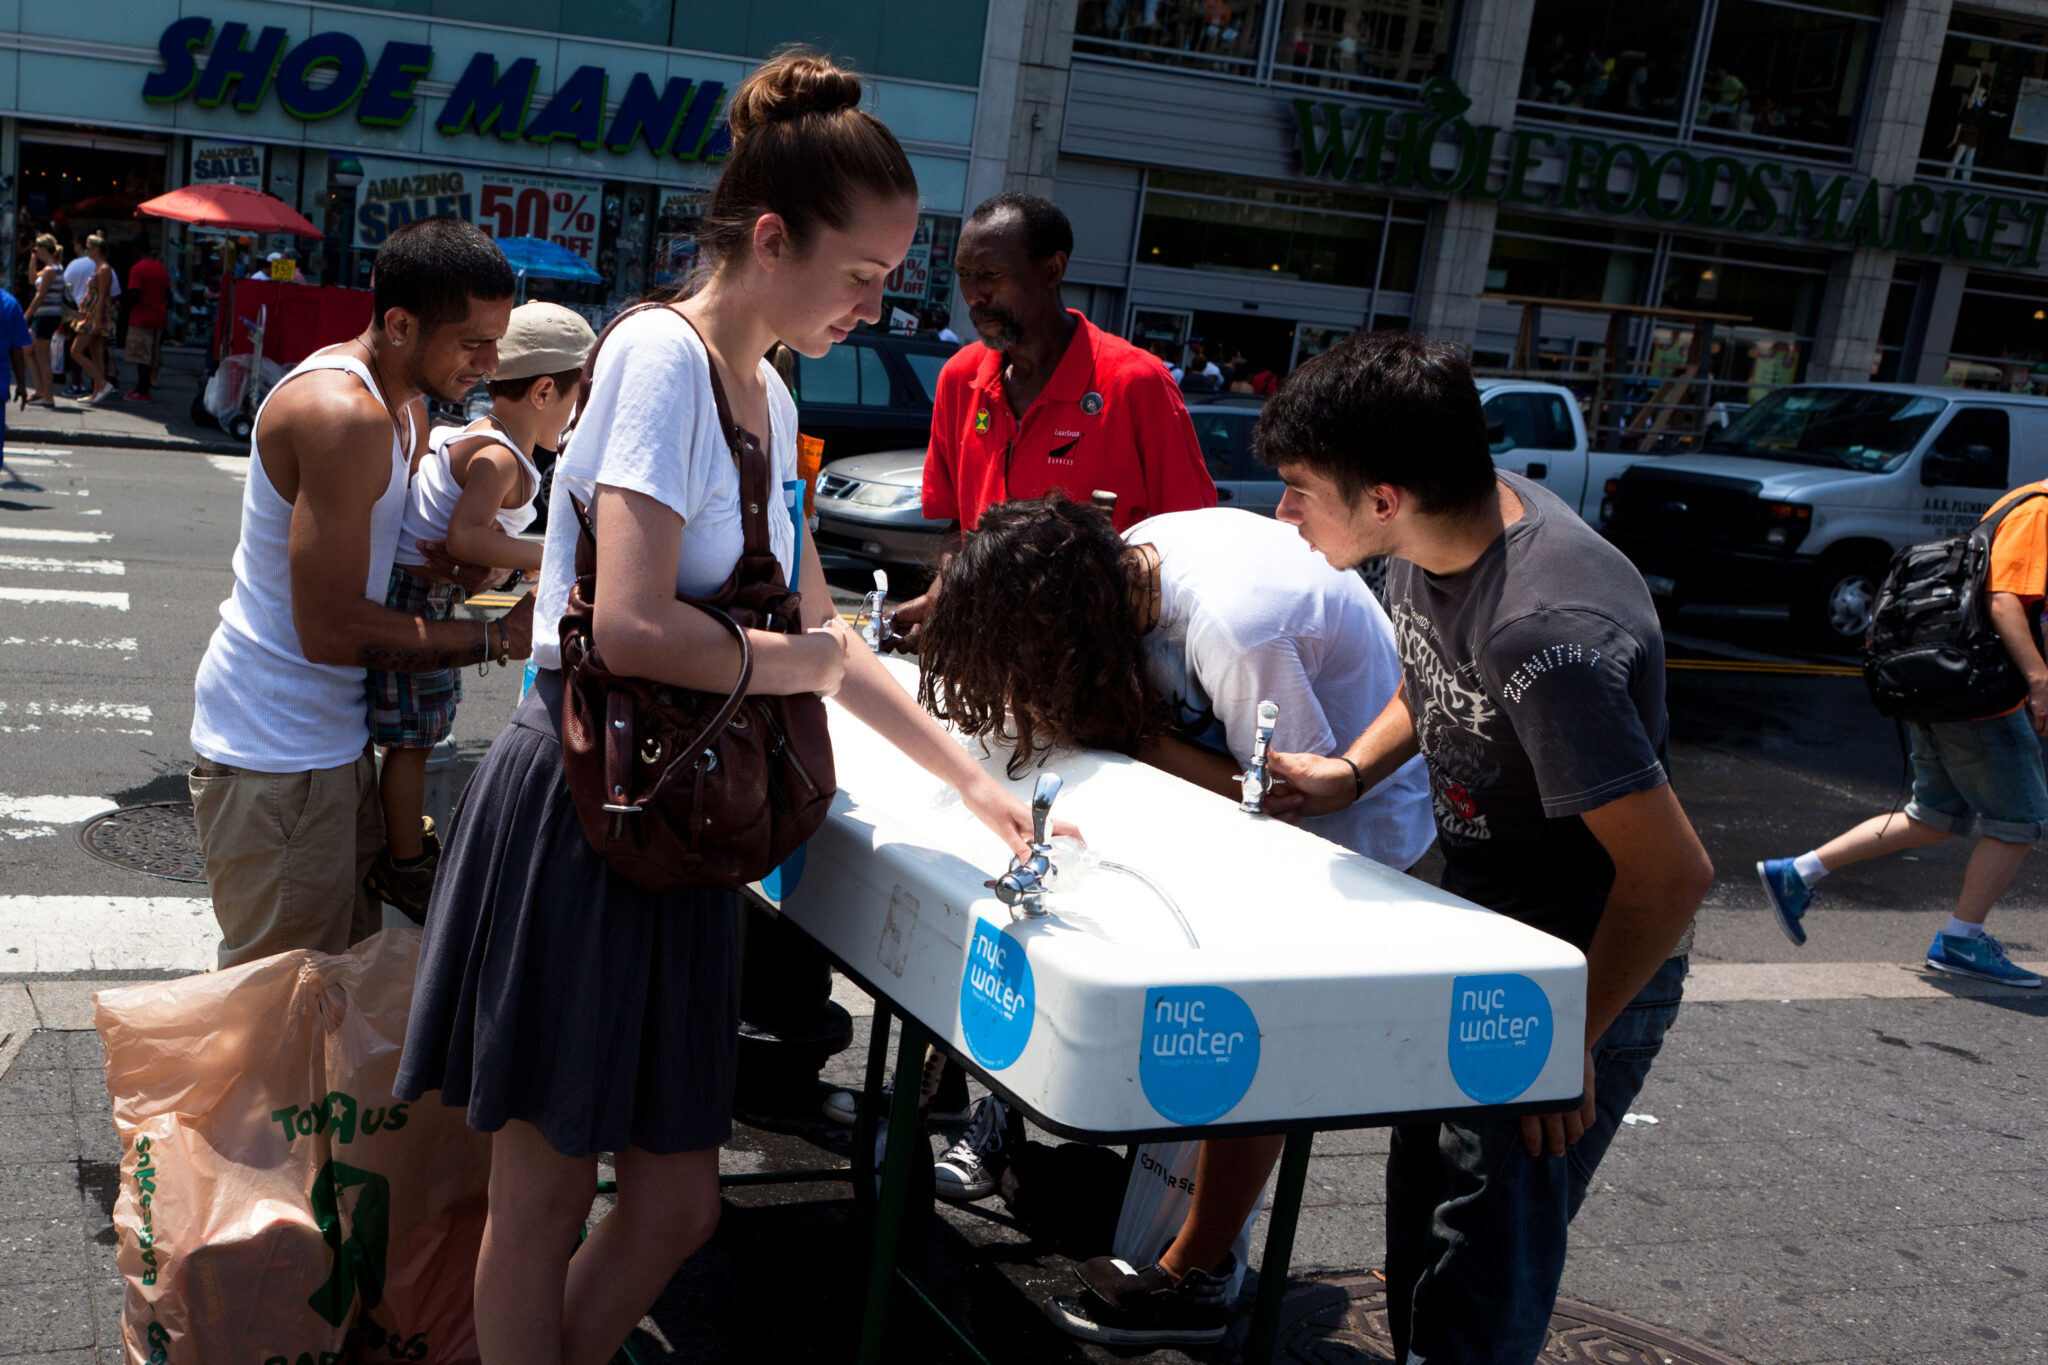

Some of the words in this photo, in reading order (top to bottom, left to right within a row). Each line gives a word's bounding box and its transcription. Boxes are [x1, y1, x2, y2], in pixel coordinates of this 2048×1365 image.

[142, 16, 435, 127] SHOE
[193, 157, 261, 180] SALE!
[197, 146, 254, 160] AMAZING
[365, 171, 465, 203] AMAZING
[1293, 97, 1557, 204] WHOLE
[1558, 136, 1782, 233] FOODS
[1780, 170, 2048, 268] MARKET
[479, 184, 596, 241] 50%
[884, 258, 926, 292] 0%
[903, 281, 925, 295] OFF
[1503, 643, 1583, 704] ZENITH
[976, 934, 1007, 970] nyc
[970, 963, 1025, 1015] water
[1462, 988, 1505, 1015] nyc
[1156, 1000, 1206, 1029] nyc
[1460, 1013, 1539, 1042] water
[1152, 1027, 1244, 1056] water
[361, 1102, 410, 1136] US
[1141, 1152, 1196, 1196] CONRSE
